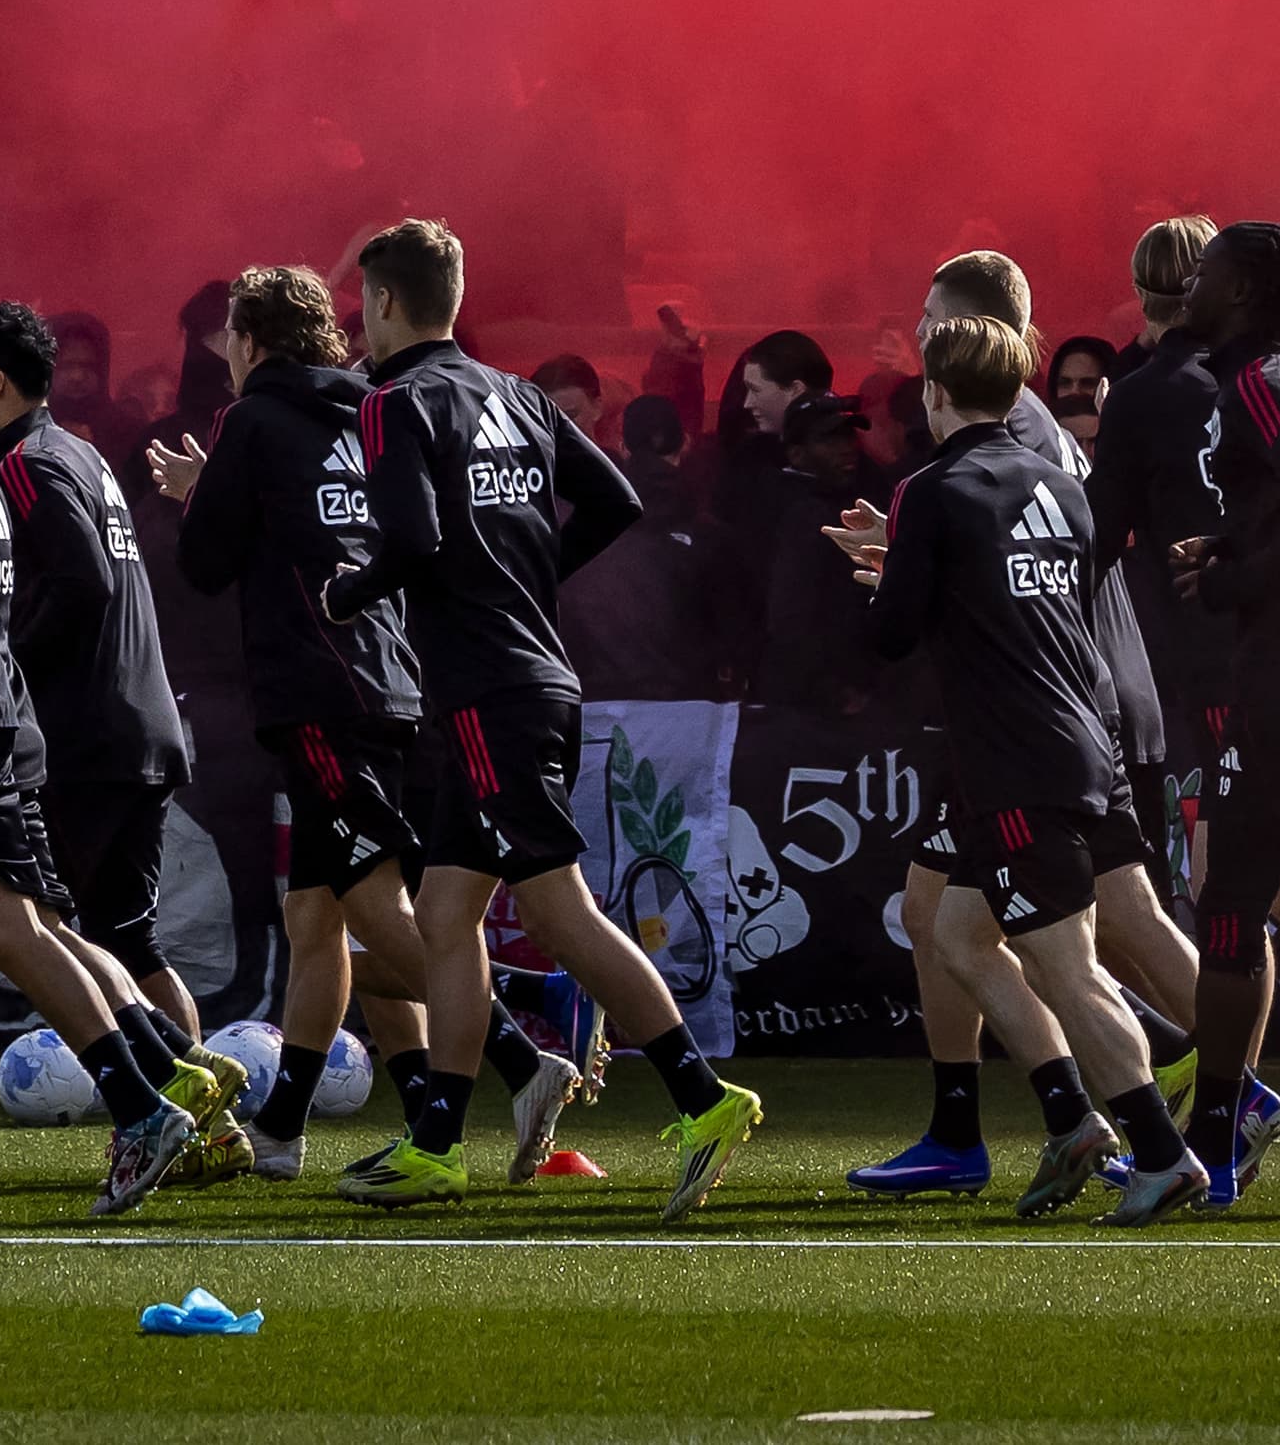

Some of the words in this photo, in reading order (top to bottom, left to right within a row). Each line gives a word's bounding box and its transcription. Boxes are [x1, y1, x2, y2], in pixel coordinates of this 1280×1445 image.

[1219, 775, 1231, 796] 19
[780, 748, 920, 873] 5th
[996, 866, 1011, 889] 17
